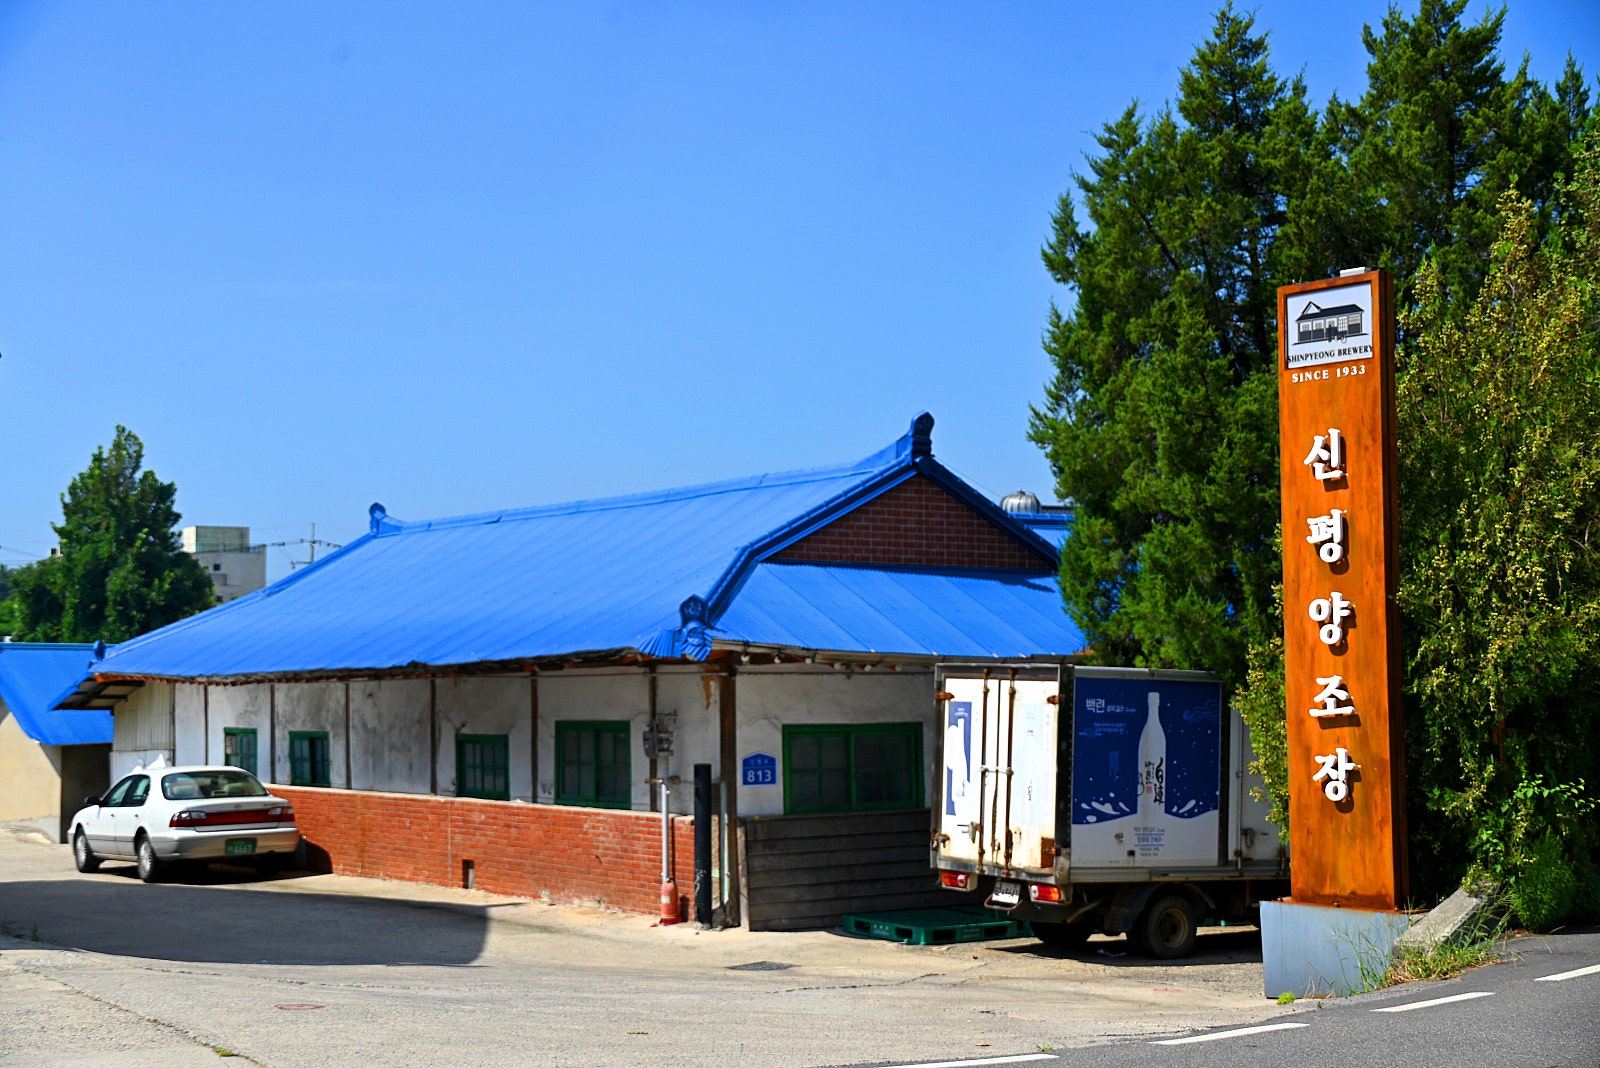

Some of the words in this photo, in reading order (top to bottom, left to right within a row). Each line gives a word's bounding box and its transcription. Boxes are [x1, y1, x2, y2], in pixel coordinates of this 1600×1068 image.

[1288, 350, 1335, 363] SHINPYEONG
[1338, 345, 1373, 356] BREWERY
[1292, 369, 1329, 383] SINCE
[1336, 364, 1366, 378] 1933
[1303, 428, 1357, 803] 신평양조장
[1086, 698, 1105, 713] 백련
[747, 769, 772, 783] 813
